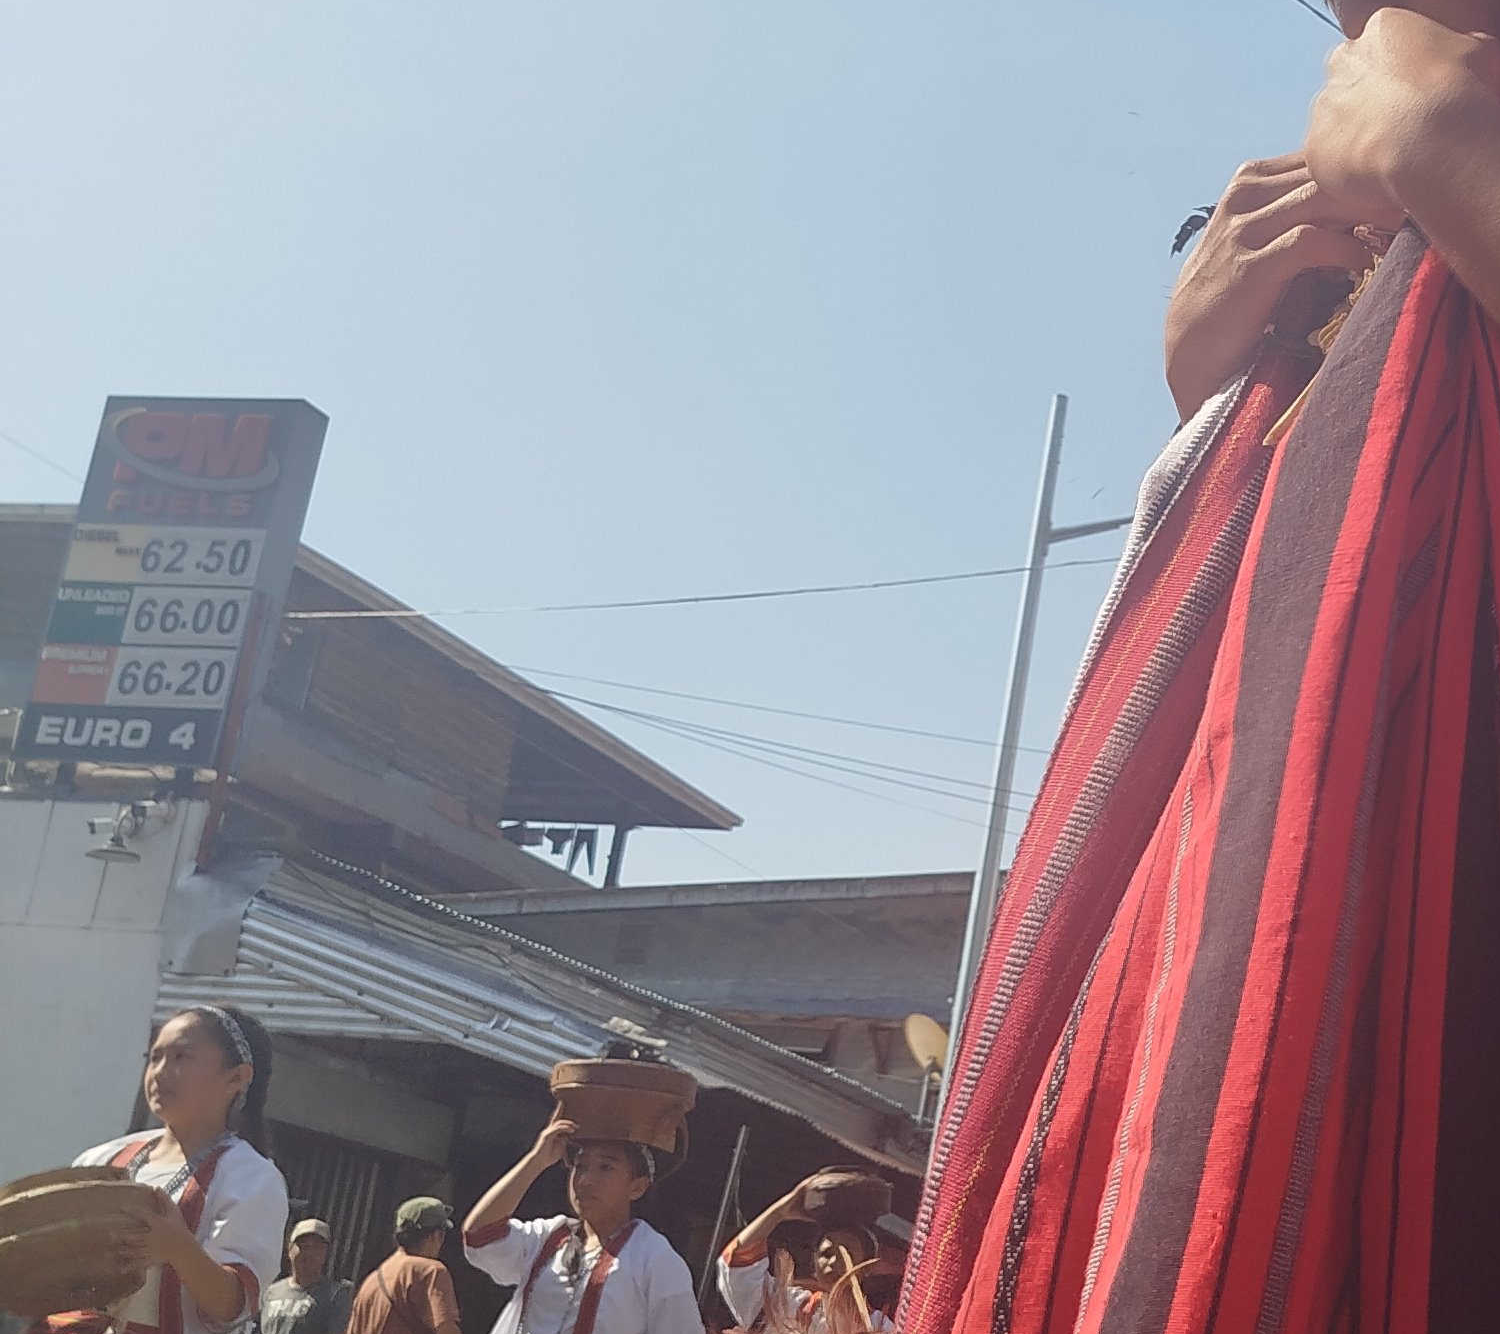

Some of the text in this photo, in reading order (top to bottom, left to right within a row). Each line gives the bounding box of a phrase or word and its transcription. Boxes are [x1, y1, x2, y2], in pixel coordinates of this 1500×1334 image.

[106, 489, 252, 517] FUELS
[140, 539, 252, 574] 62.50
[133, 599, 240, 634] 66.00
[117, 660, 226, 696] 66.20
[35, 716, 195, 750] EURO 4
